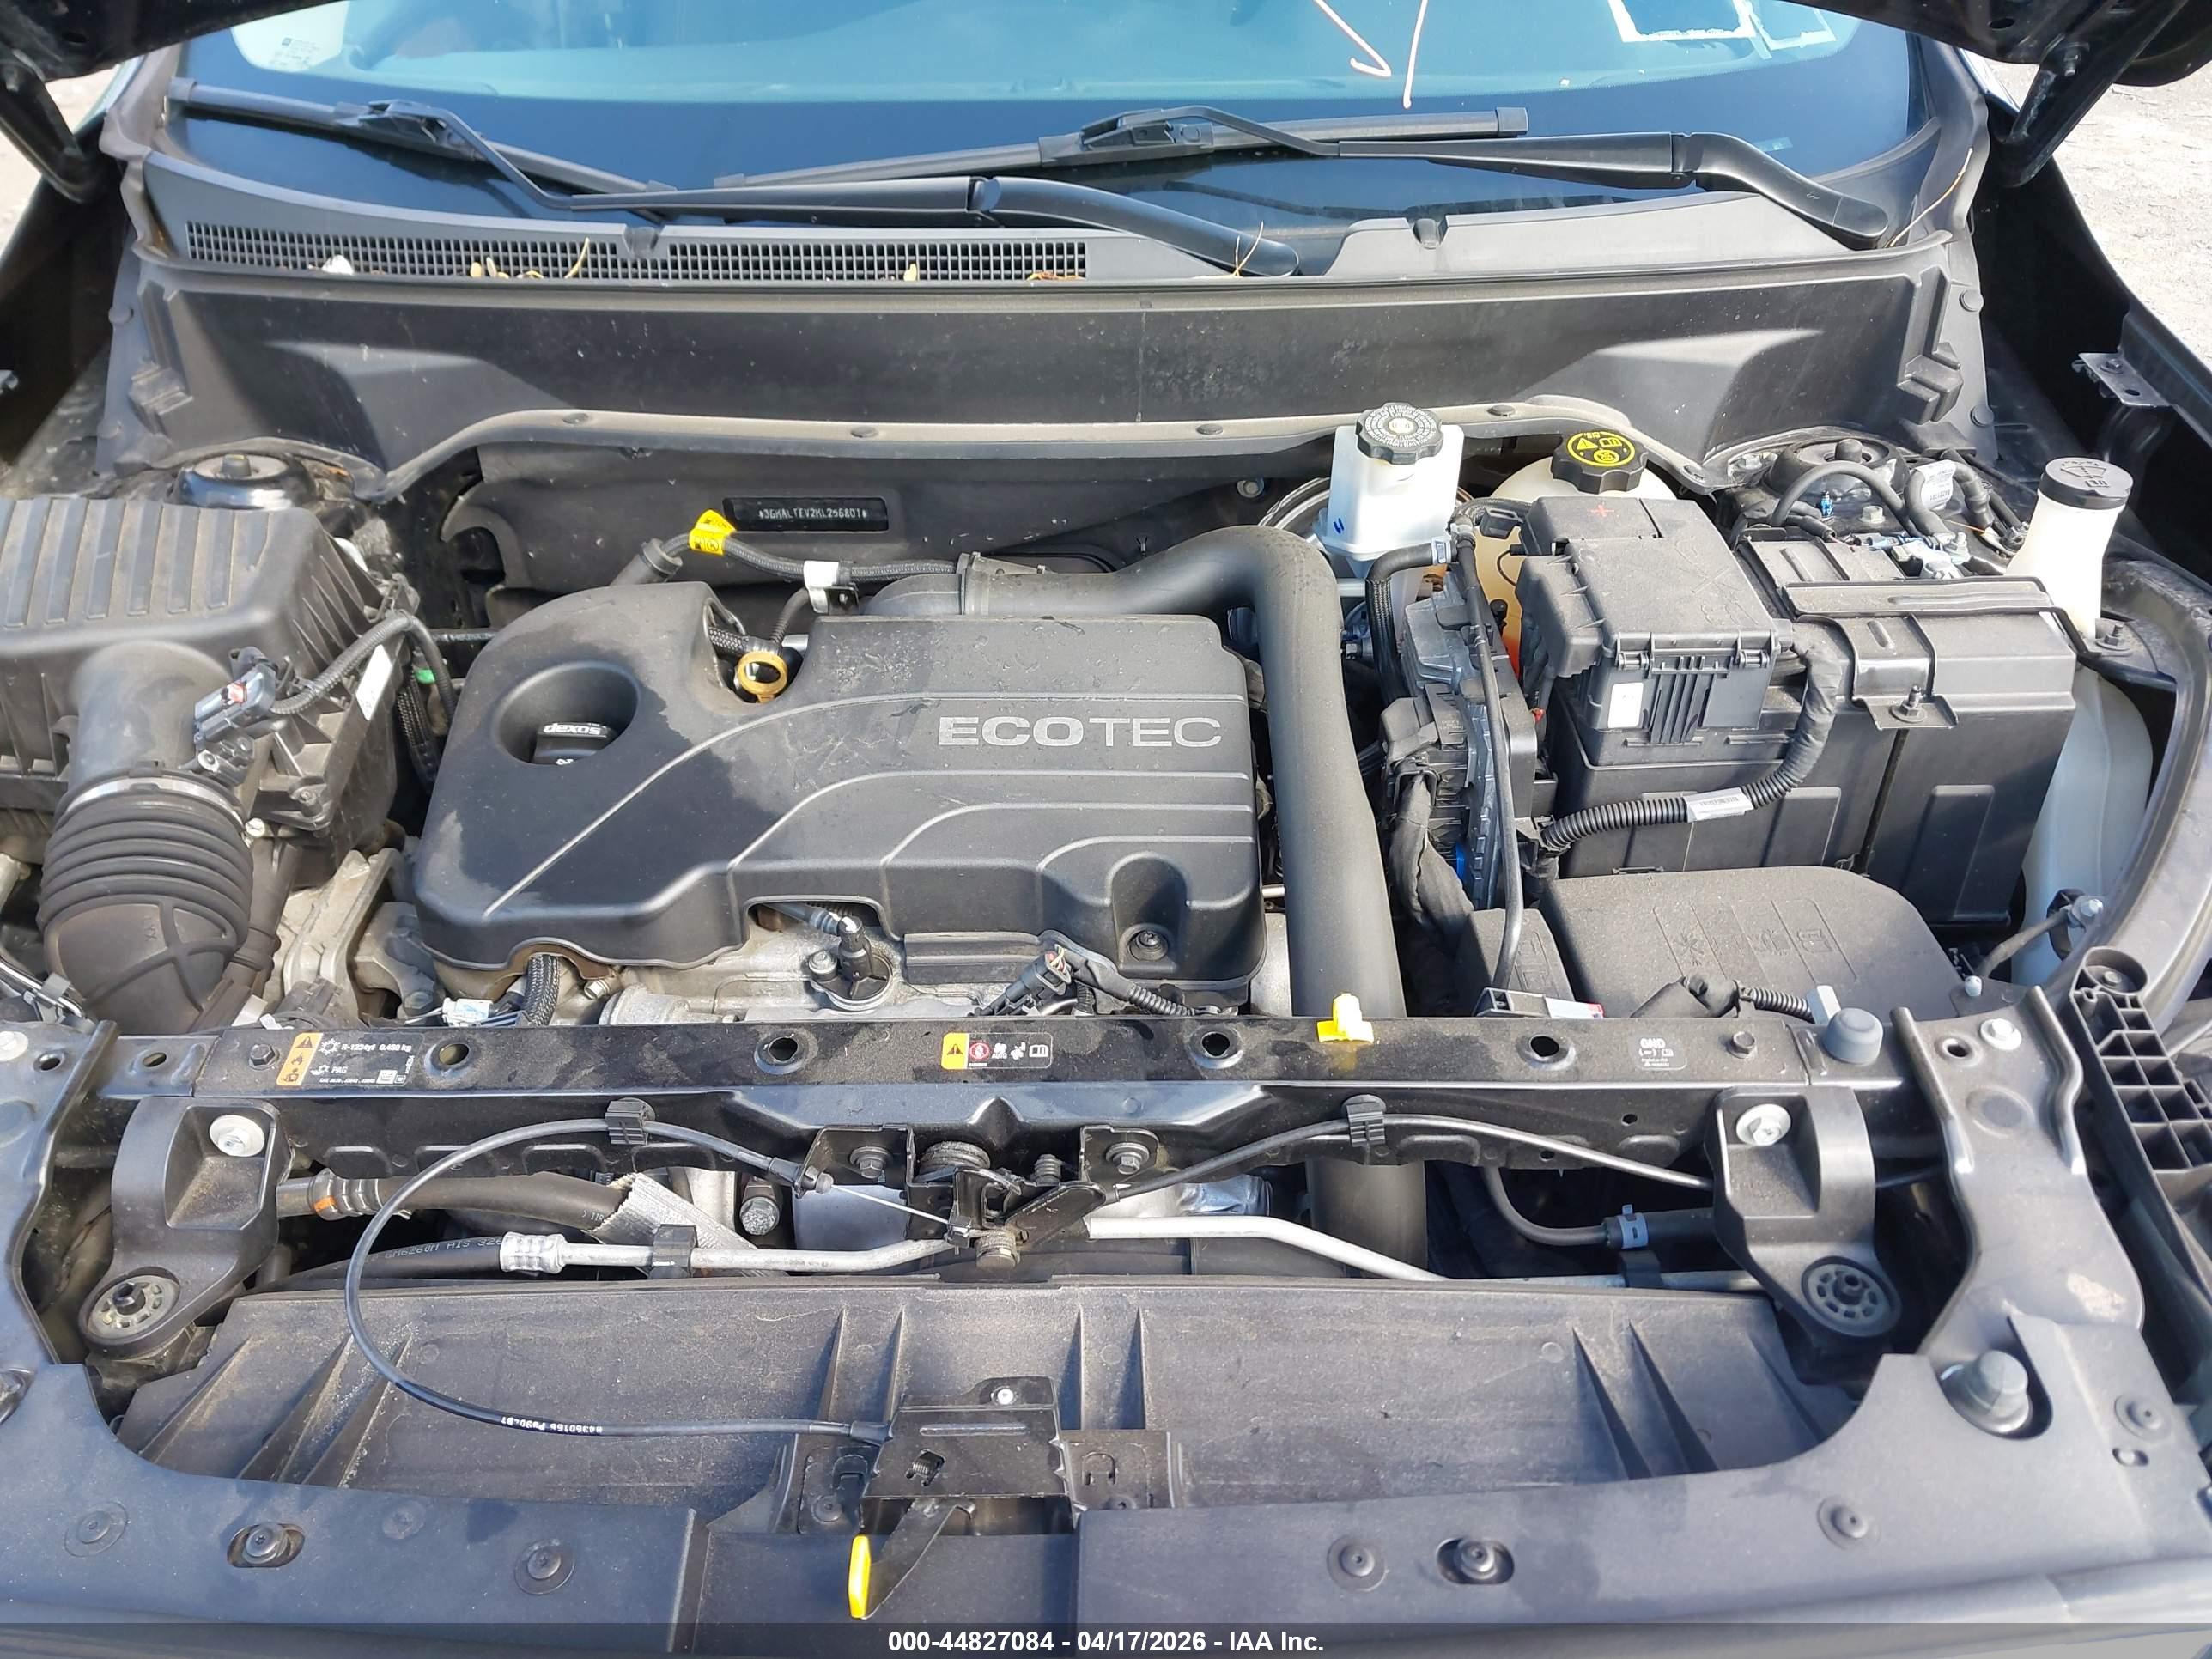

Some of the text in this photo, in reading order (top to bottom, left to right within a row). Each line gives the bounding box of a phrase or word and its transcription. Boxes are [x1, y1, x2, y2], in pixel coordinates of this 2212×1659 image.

[543, 723, 602, 736] dexos
[938, 715, 1223, 747] ECOTEC
[331, 1065, 349, 1074] PAG
